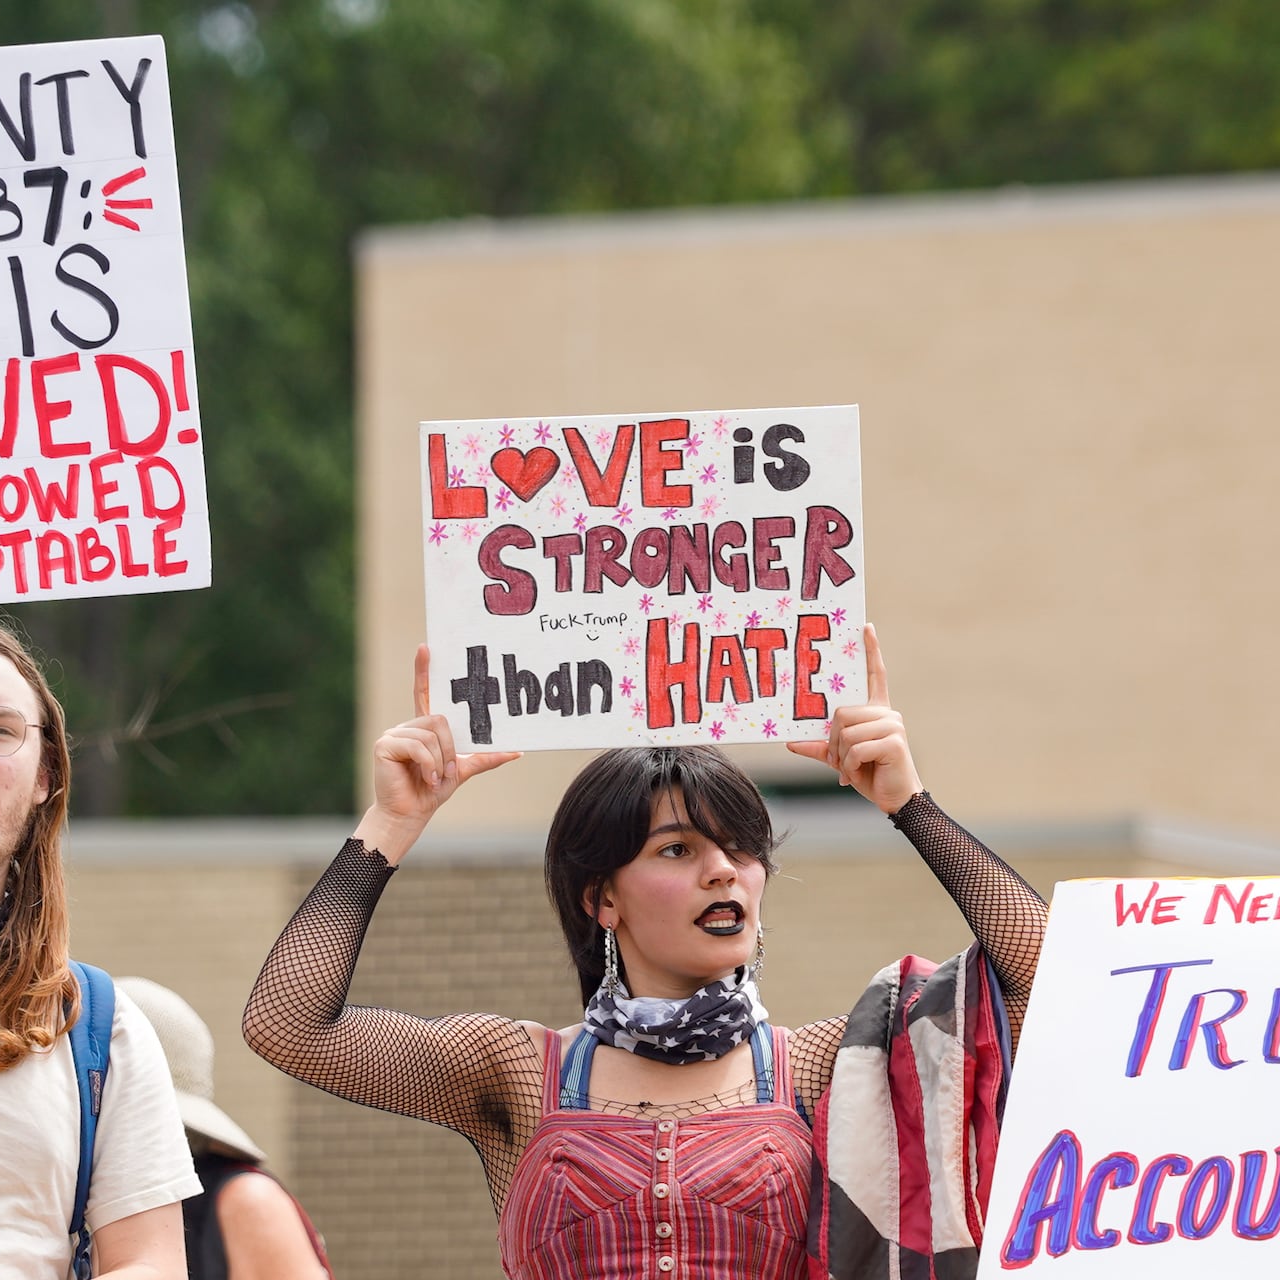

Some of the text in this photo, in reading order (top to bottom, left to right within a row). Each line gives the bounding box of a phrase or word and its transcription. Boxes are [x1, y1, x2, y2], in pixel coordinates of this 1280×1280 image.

[8, 242, 119, 357] IS
[477, 504, 856, 616] STRONGER
[450, 613, 832, 745] than HATE
